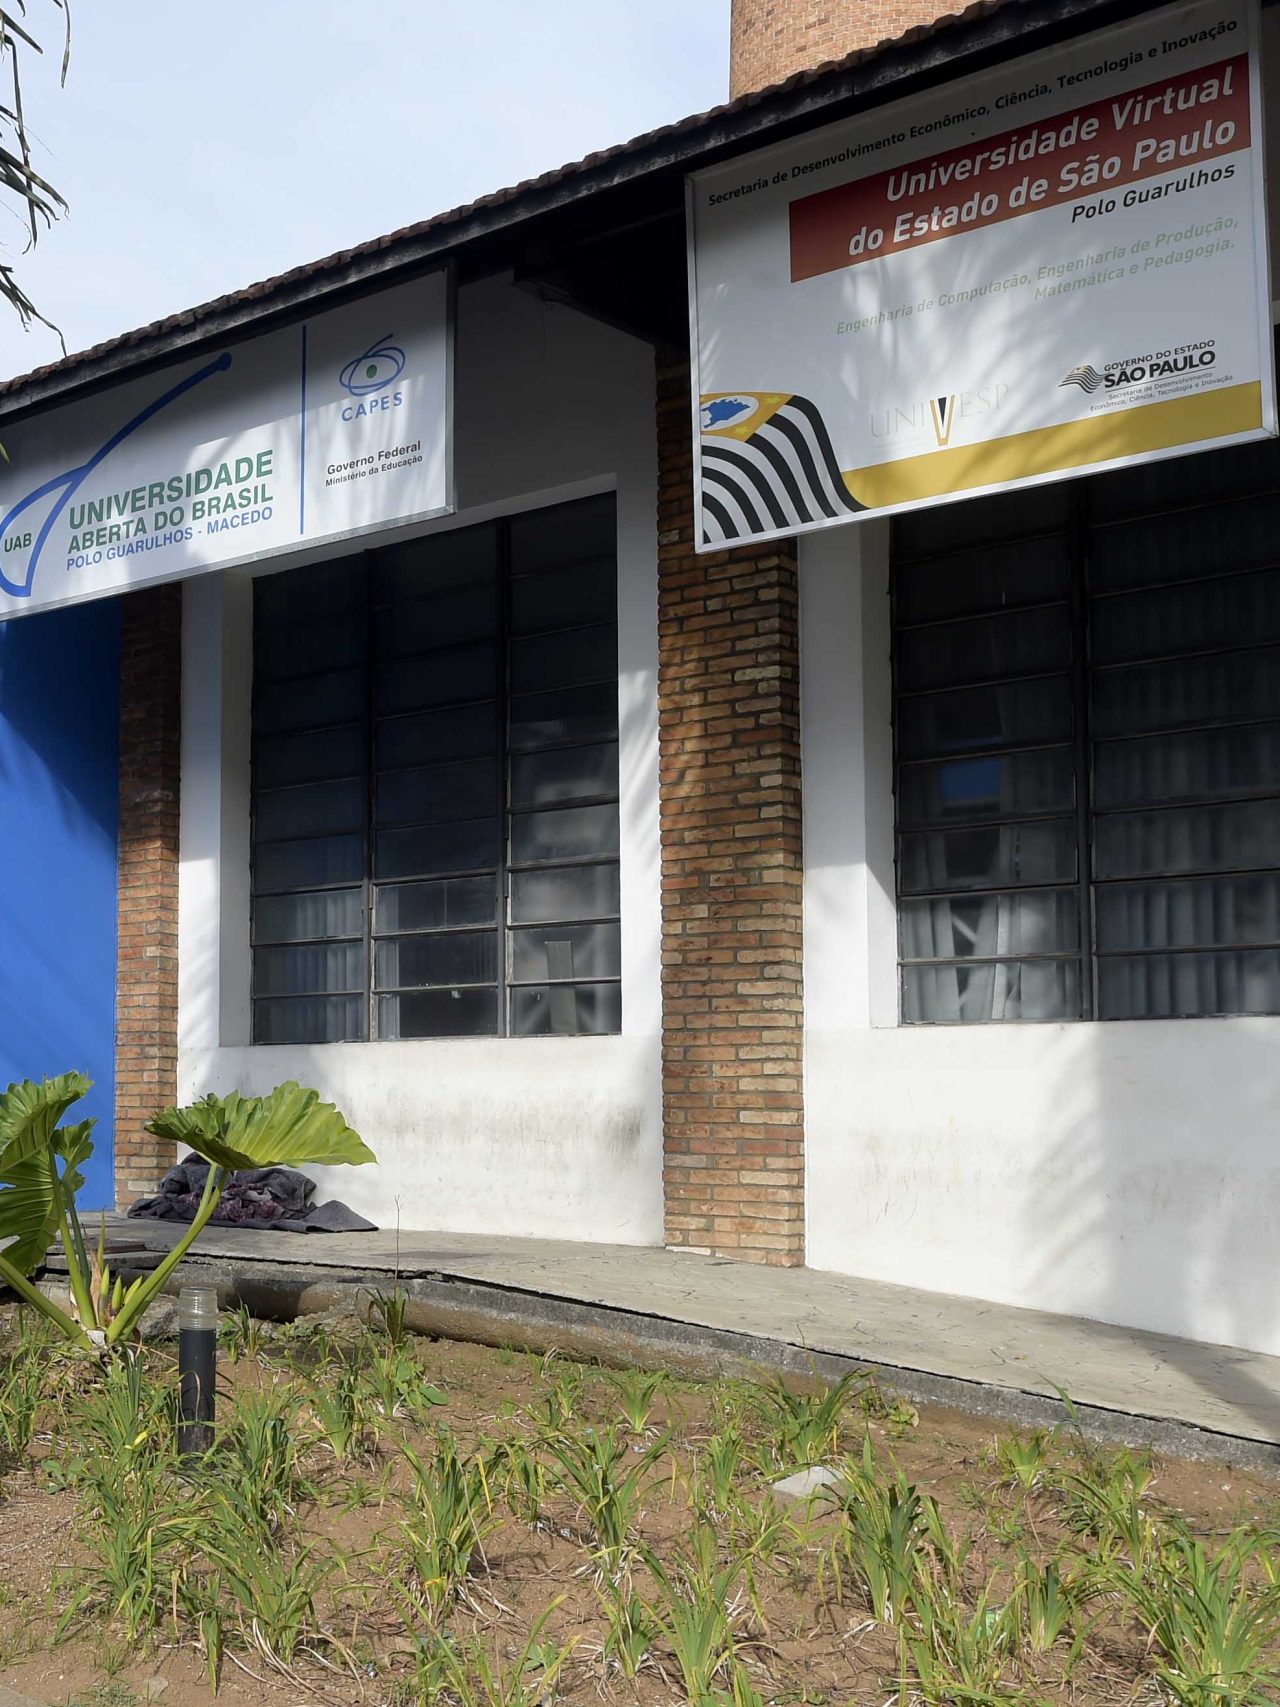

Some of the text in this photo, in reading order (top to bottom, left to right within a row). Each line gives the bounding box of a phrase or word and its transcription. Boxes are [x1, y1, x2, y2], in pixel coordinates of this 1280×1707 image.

[709, 20, 1238, 206] Secretaria de Desenvolvimento Econômico, Ciência, Tecnologia e Inovação
[886, 65, 1234, 202] Universidade Virtual
[848, 120, 1236, 256] do Estado de São Paulo
[1071, 164, 1235, 223] Polo Guarulhos
[836, 217, 1238, 335] Engenharia de Computação, Engenharia de Produção,
[1035, 237, 1235, 301] Matemática e Pedagogia.
[1104, 339, 1215, 372] GOVERNO DO ESTADO
[1104, 350, 1216, 389] SÃO PAULO
[341, 391, 403, 422] CAPES
[325, 454, 423, 487] Ministério da Educação
[327, 440, 421, 475] Governo Federal
[67, 483, 274, 555] ABERTA DO BRASIL
[69, 450, 273, 530] UNIVERSIDADE
[4, 532, 32, 553] UAB
[66, 551, 102, 571] POLO
[106, 526, 193, 561] GUARULHOS
[207, 506, 273, 535] MACEDO
